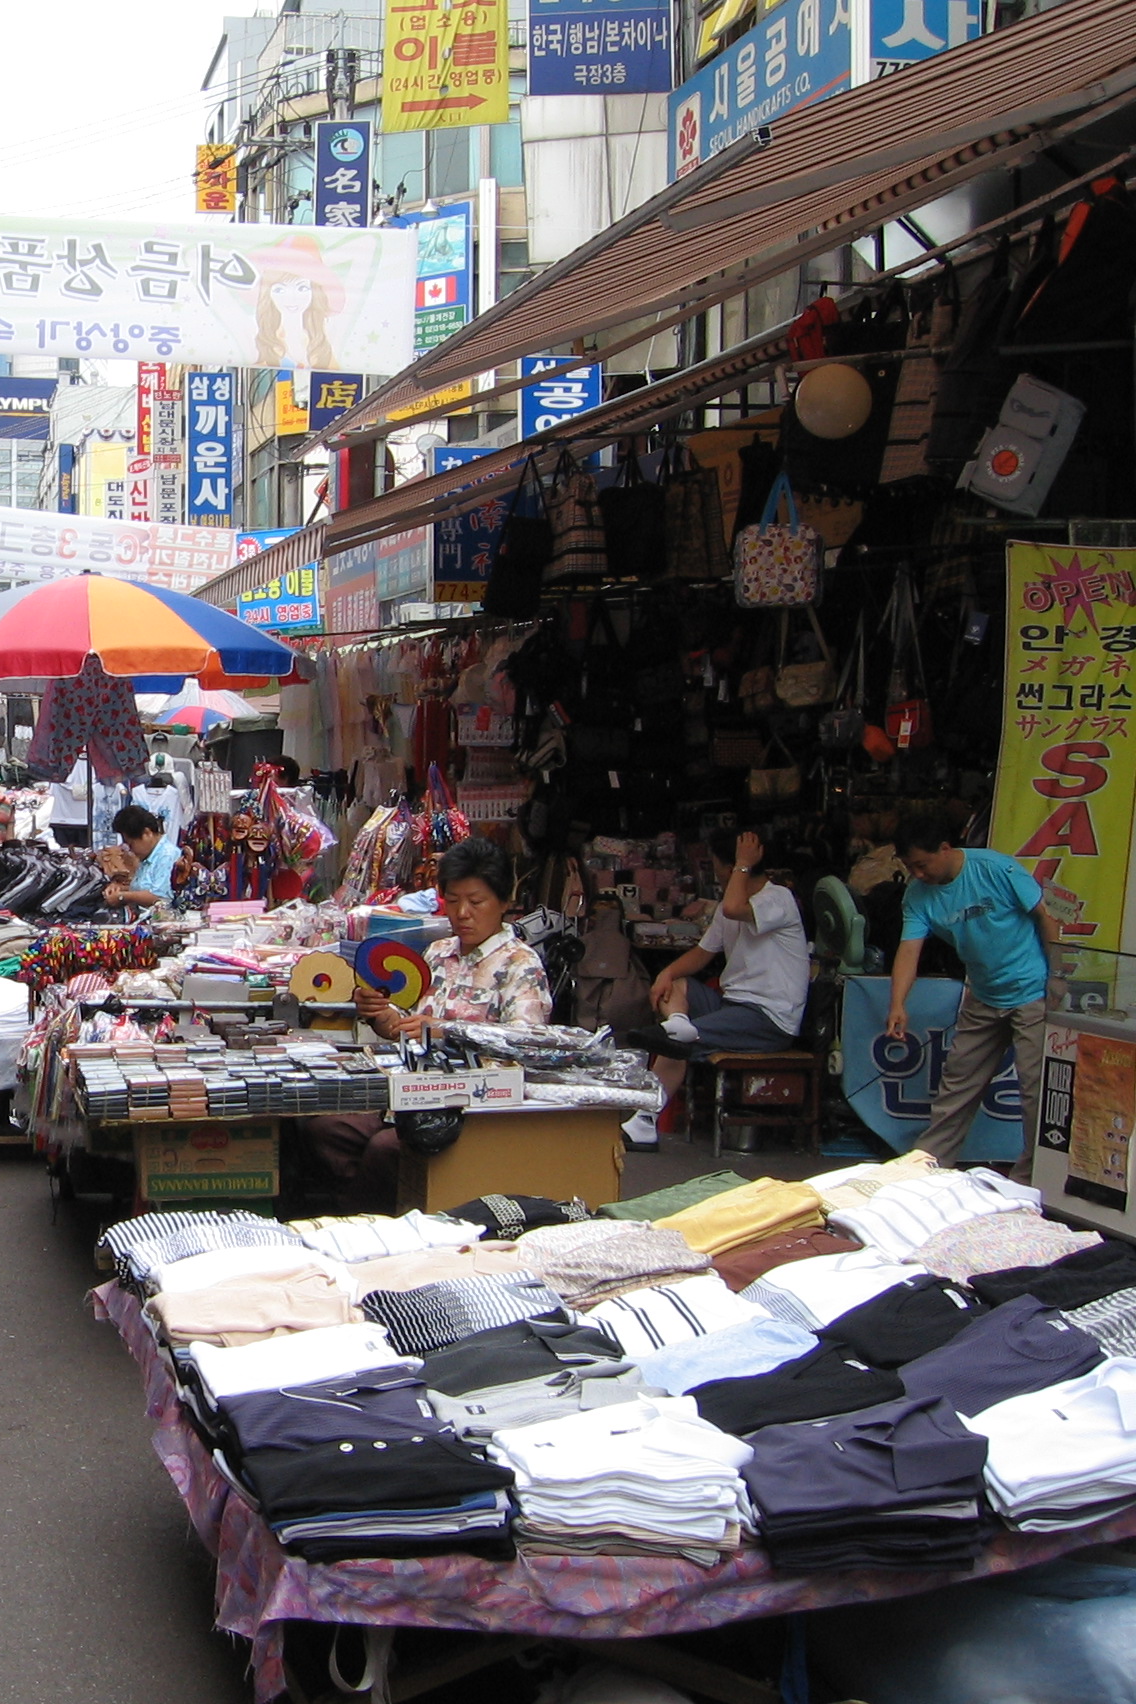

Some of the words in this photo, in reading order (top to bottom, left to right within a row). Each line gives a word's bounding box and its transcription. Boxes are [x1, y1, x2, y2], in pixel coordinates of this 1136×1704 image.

[393, 30, 497, 71] 이불
[532, 16, 668, 58] 한국/행남/본차이나
[449, 68, 502, 88] 영업중)
[573, 62, 627, 86] 극장3층
[735, 83, 793, 135] HANDICRAFTS
[323, 167, 362, 228] 名家
[190, 376, 231, 401] 삼성
[316, 380, 359, 409] 店
[193, 404, 229, 511] 까운사
[1022, 569, 1136, 613] OPEN
[1019, 624, 1136, 653] 안경
[1019, 655, 1132, 679] メガネ
[1015, 713, 1129, 741] サングラス
[401, 1082, 466, 1093] CHERRIES
[150, 1179, 209, 1192] BANANAS
[211, 1177, 269, 1191] PREMIUM
